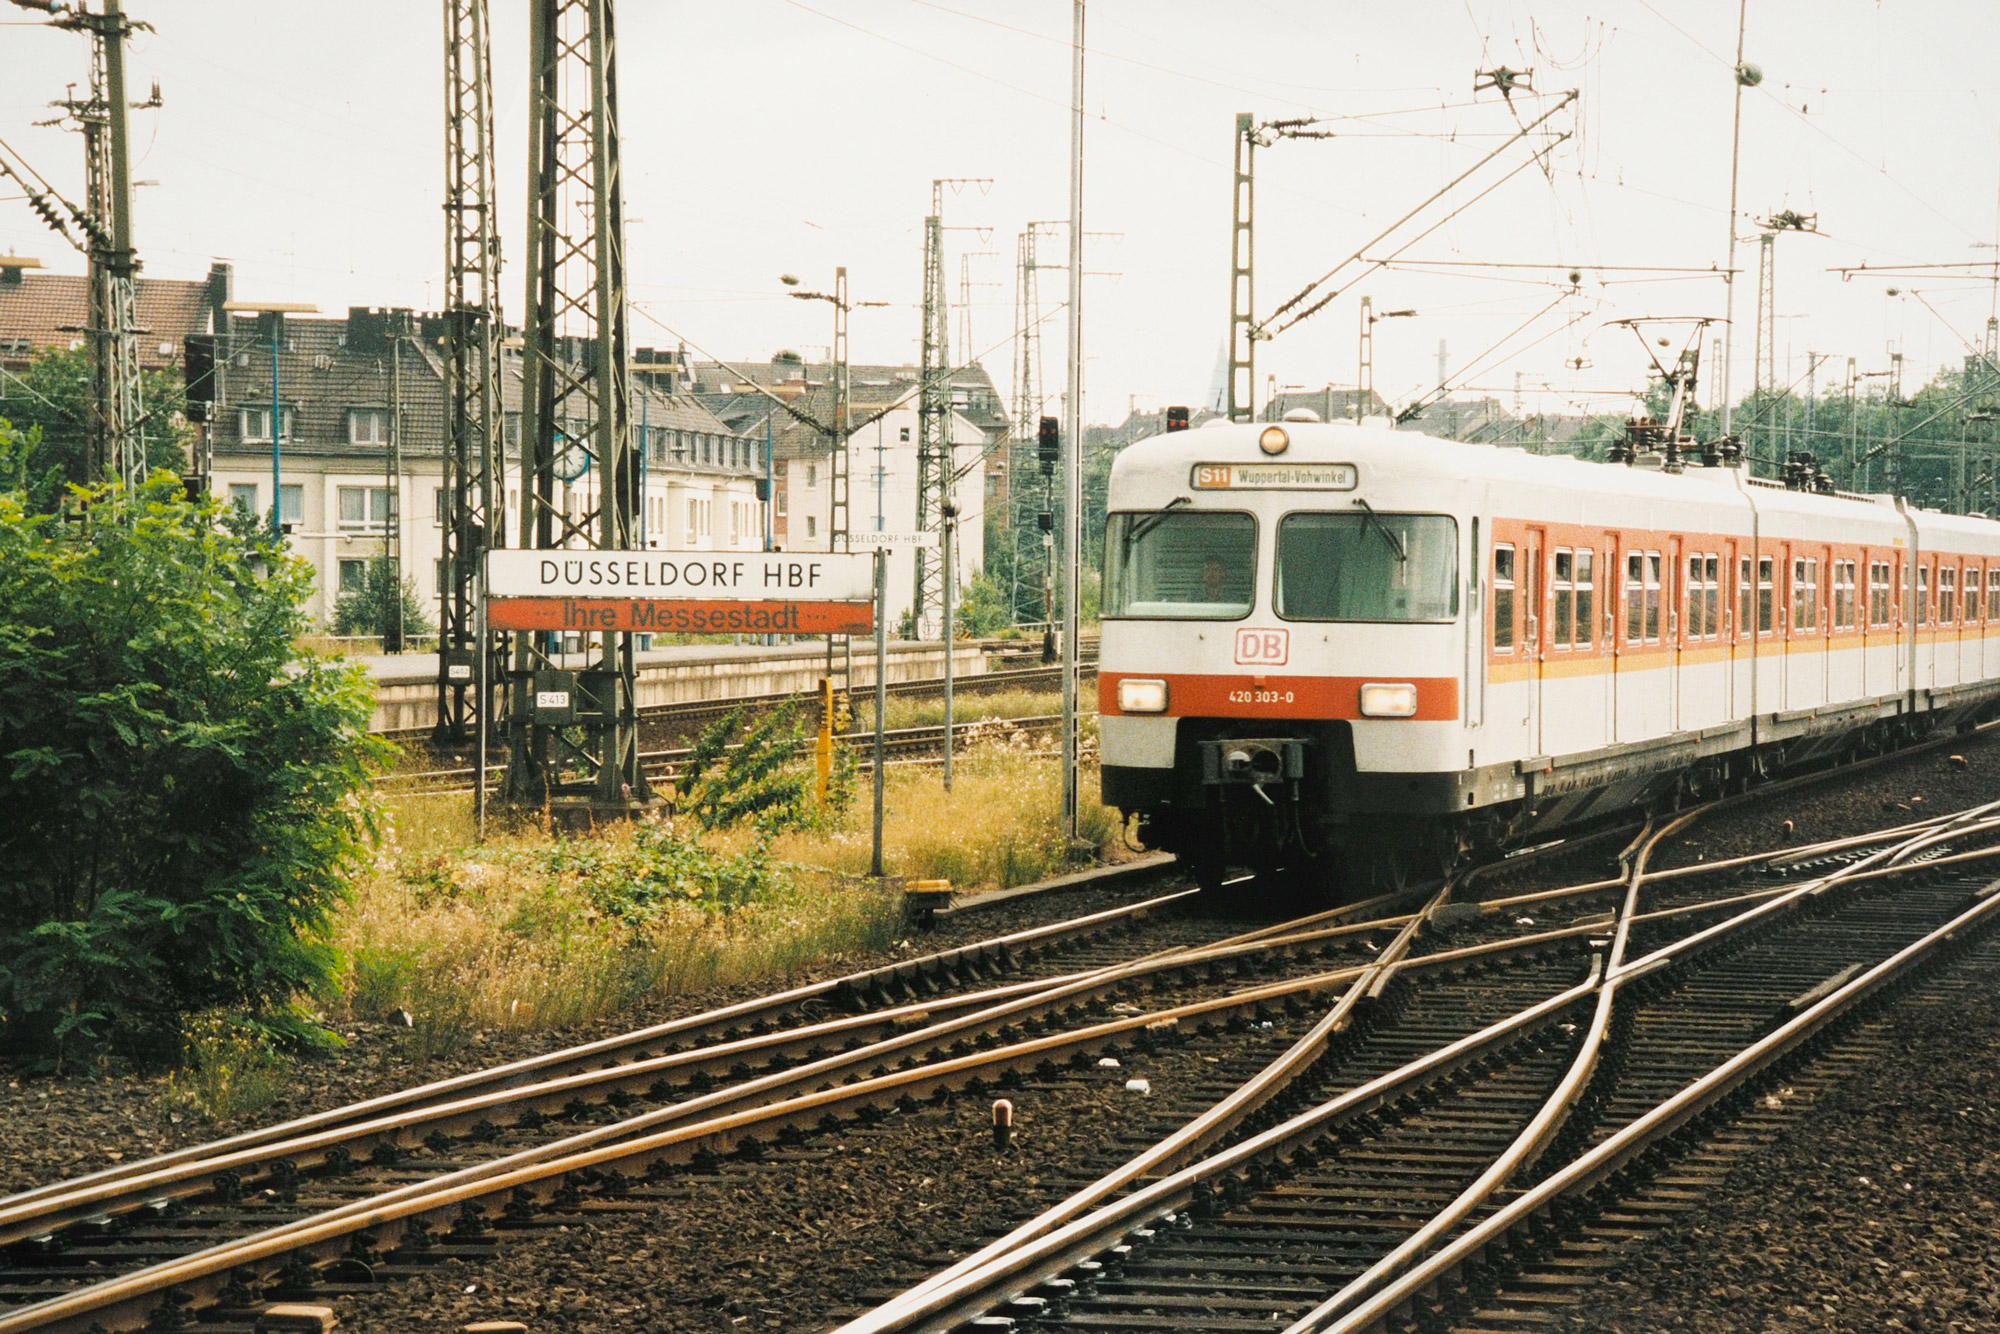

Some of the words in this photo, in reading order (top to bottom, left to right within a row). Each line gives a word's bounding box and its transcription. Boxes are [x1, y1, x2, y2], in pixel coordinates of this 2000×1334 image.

[1200, 467, 1228, 483] S11
[904, 535, 923, 543] HBF
[541, 560, 744, 587] DÜSSELDORF
[764, 563, 822, 588] HBF
[631, 602, 800, 630] Messestadt
[1242, 634, 1282, 658] DB
[1229, 691, 1252, 703] 420
[1255, 691, 1294, 703] 303-0
